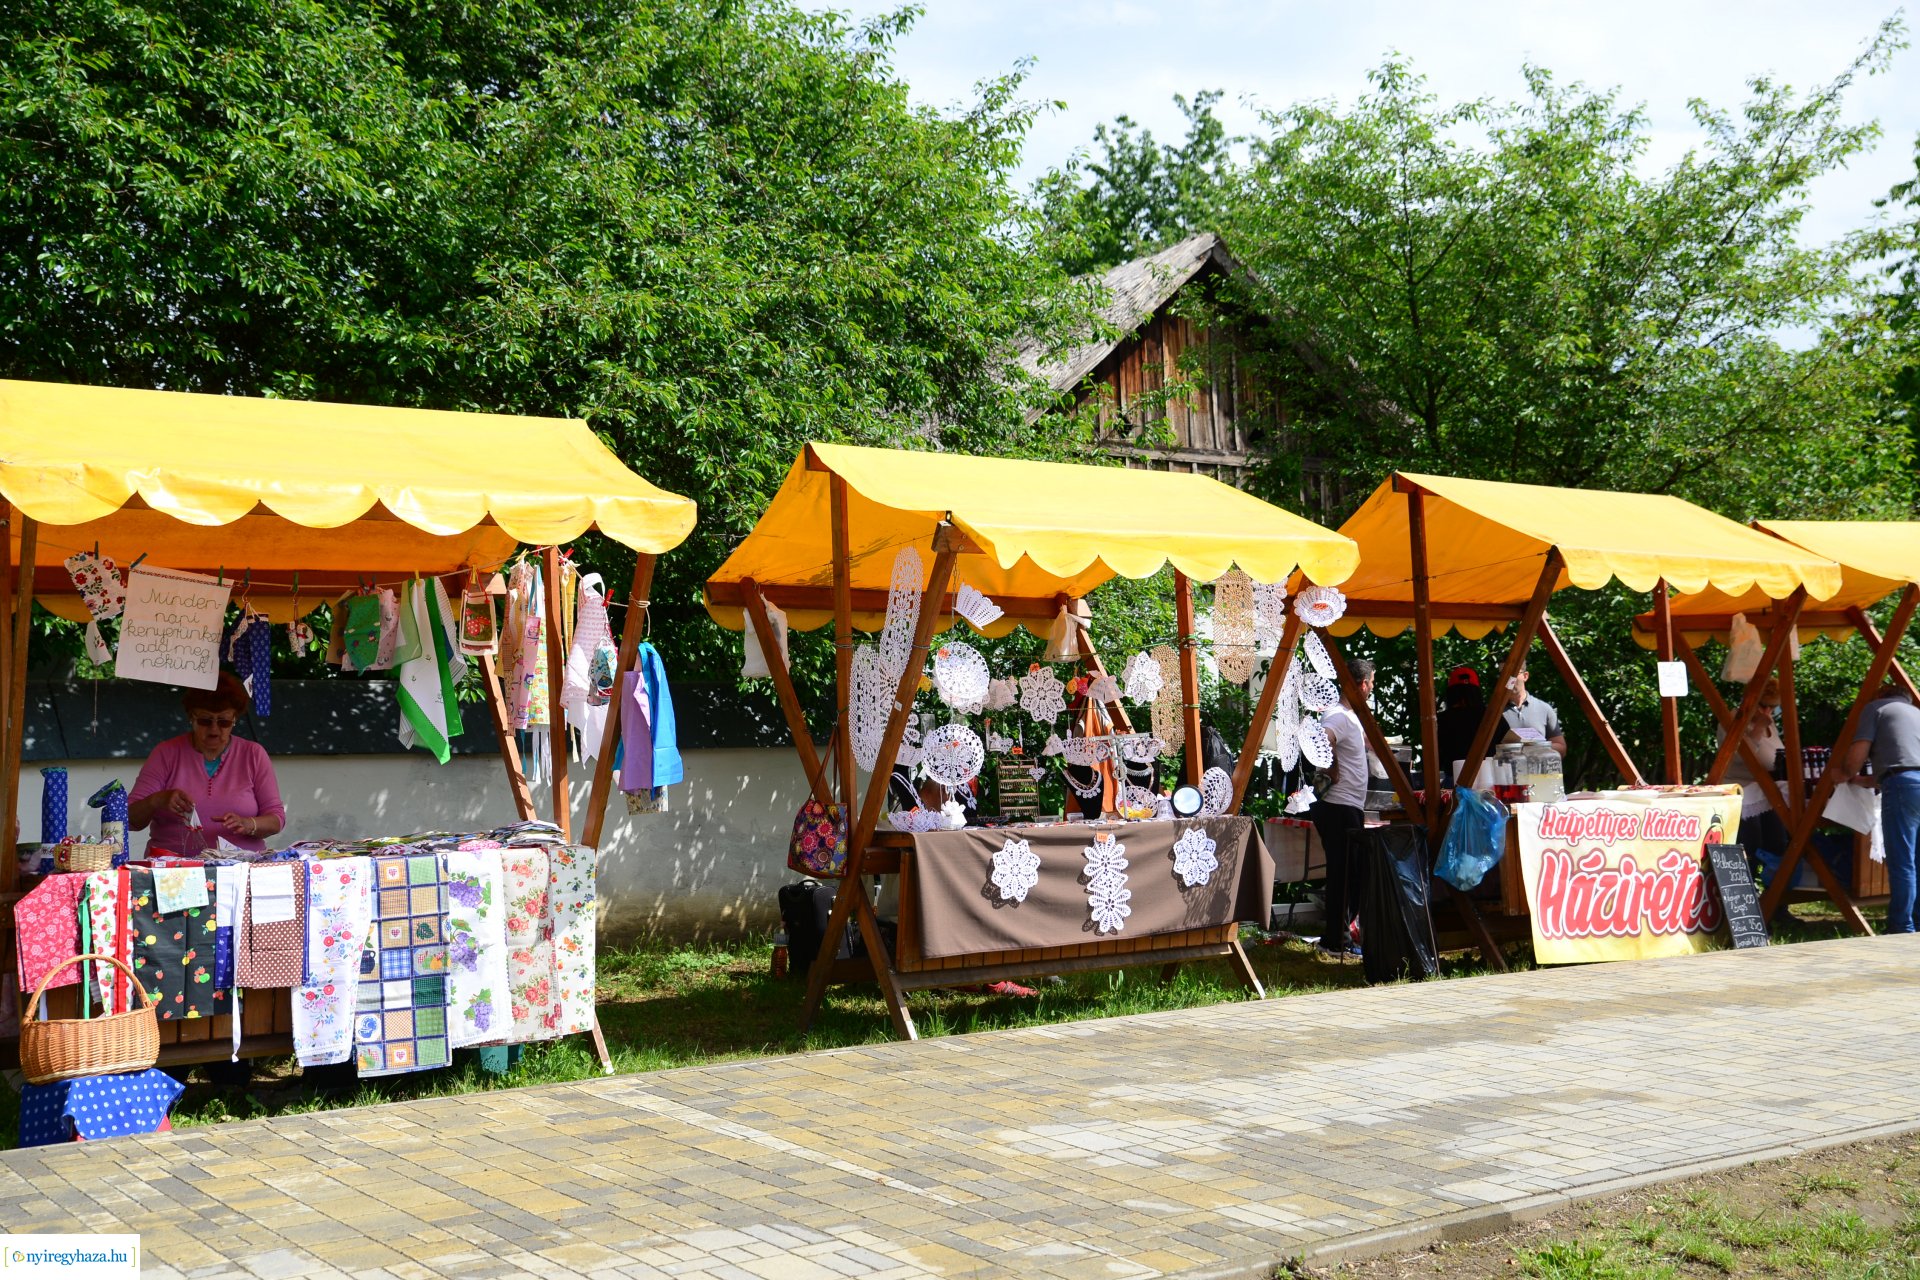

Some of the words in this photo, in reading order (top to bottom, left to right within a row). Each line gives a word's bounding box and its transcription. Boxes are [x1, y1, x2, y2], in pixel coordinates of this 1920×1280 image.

[155, 612, 200, 627] napi
[136, 638, 169, 654] add
[174, 645, 210, 663] meg
[1540, 805, 1639, 846] Hatpettyes
[1641, 808, 1699, 841] Katica
[1537, 850, 1723, 938] Házirétes
